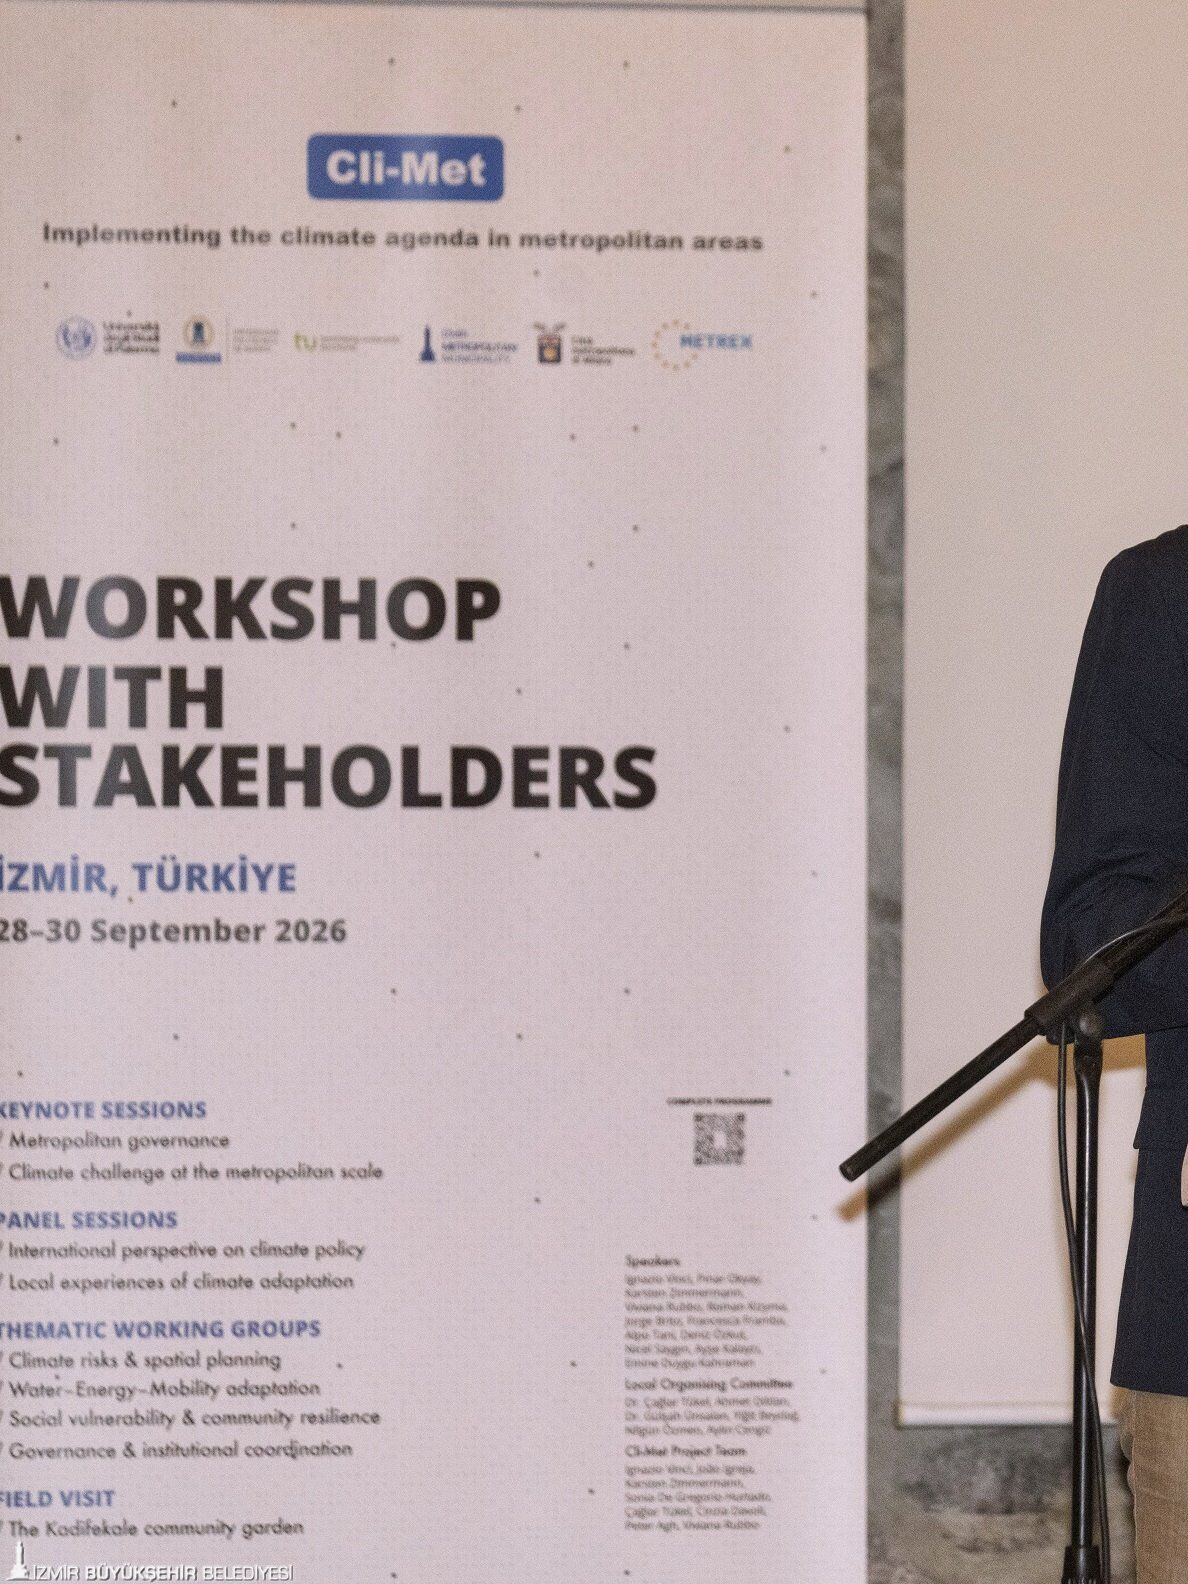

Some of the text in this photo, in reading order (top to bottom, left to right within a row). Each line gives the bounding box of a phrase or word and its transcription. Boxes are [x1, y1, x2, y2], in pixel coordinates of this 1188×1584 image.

[327, 151, 488, 188] Cli-Met
[42, 222, 764, 254] Implementing the climate agenda in metropolitan areas
[679, 333, 753, 349] METREX
[0, 575, 501, 643] WORKSHOP
[0, 664, 224, 729] WITH
[0, 743, 658, 810] STAKEHOLDERS
[132, 854, 296, 893] TÜRKİYE
[91, 917, 266, 951] September
[274, 919, 348, 944] 2026
[101, 1101, 207, 1120] SESSIONS
[8, 1131, 230, 1152] Metropolitan governance
[9, 1161, 384, 1185] Climate challenge at the metropolitan scale
[72, 1211, 178, 1230] SESSIONS
[8, 1239, 366, 1262] International perspective on climate policy
[8, 1271, 354, 1295] Local experiences of climate adaptation
[113, 1320, 225, 1339] WORKING
[231, 1319, 321, 1339] GROUPS
[9, 1350, 282, 1372] Climate risks & spatial planning
[226, 1379, 321, 1401] adaptation
[9, 1407, 382, 1430] Social vulnerability & community resilience
[9, 1439, 353, 1461] Governance & institutional coordination
[59, 1490, 116, 1508] VISIT
[9, 1518, 305, 1540] The Kadifekale community garden
